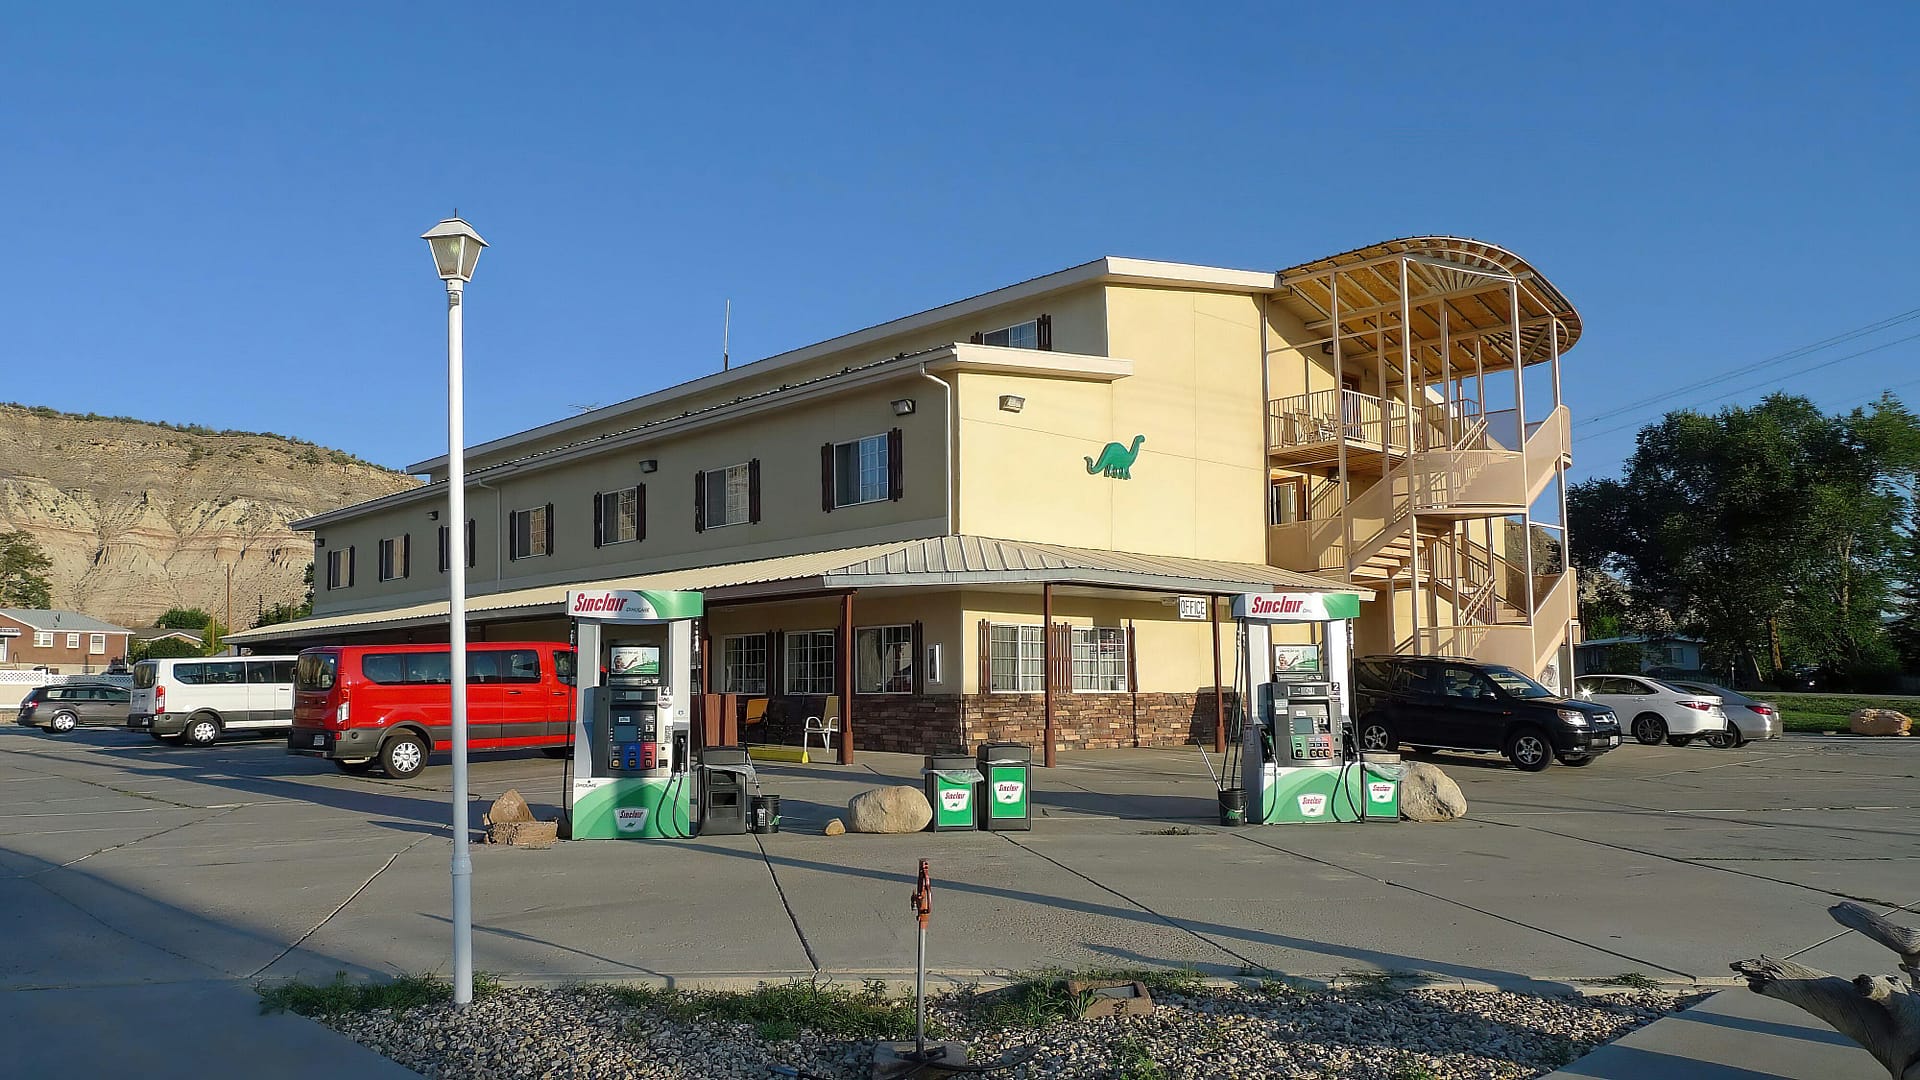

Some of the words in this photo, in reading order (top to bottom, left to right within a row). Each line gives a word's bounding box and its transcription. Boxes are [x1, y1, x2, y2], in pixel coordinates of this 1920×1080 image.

[574, 592, 628, 612] Sinclair
[1252, 596, 1303, 613] Sinclair
[1180, 599, 1205, 615] OFFICE
[1332, 682, 1340, 690] 2
[662, 686, 671, 696] 4
[998, 784, 1019, 792] Sinclair
[944, 791, 966, 800] Sinclair
[619, 810, 644, 819] Sinclair
